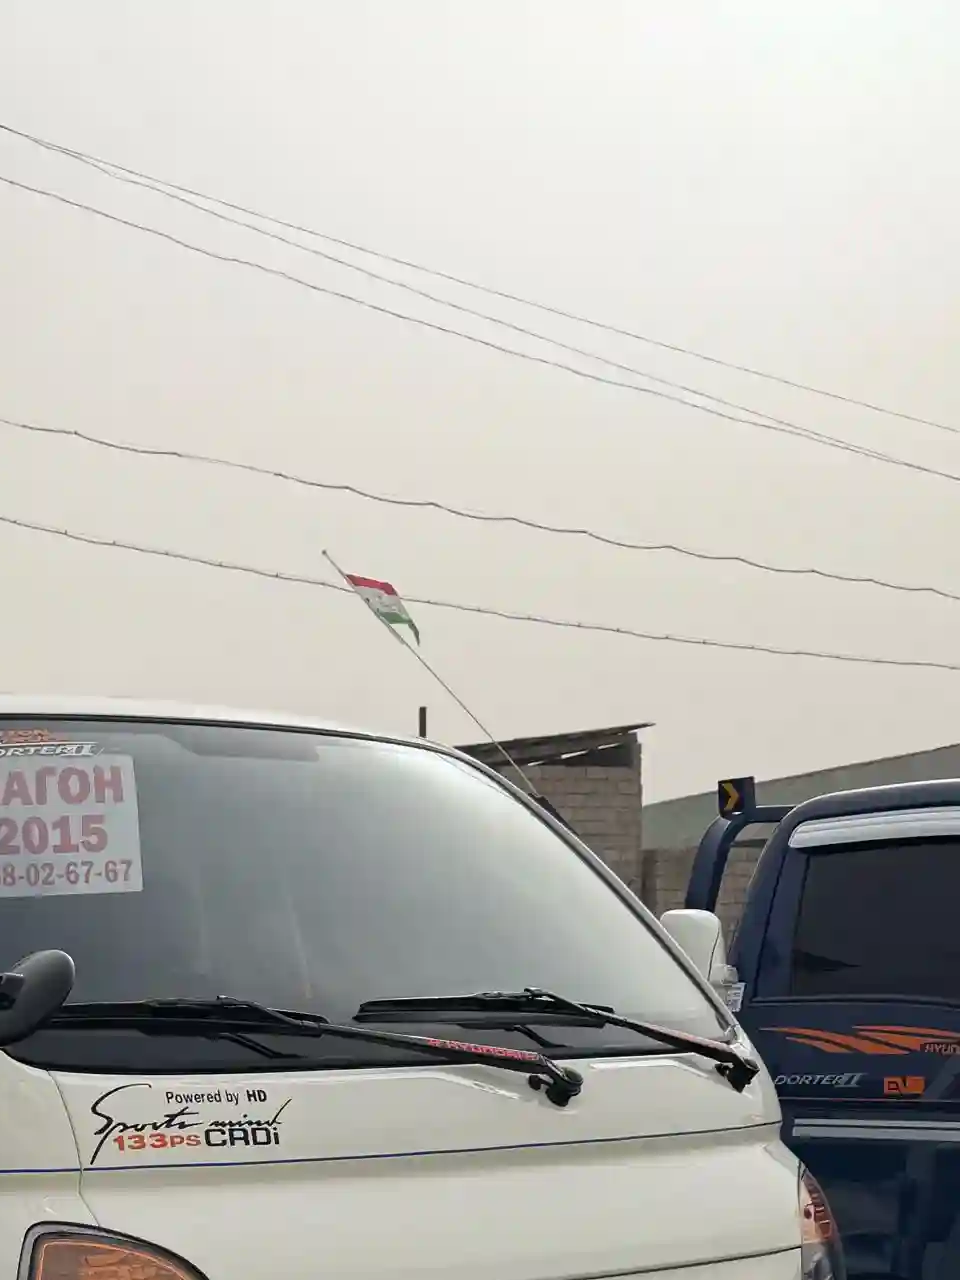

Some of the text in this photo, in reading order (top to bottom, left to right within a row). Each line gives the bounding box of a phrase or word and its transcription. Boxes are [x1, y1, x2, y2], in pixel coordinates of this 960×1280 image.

[165, 1089, 267, 1105] Powered by HD
